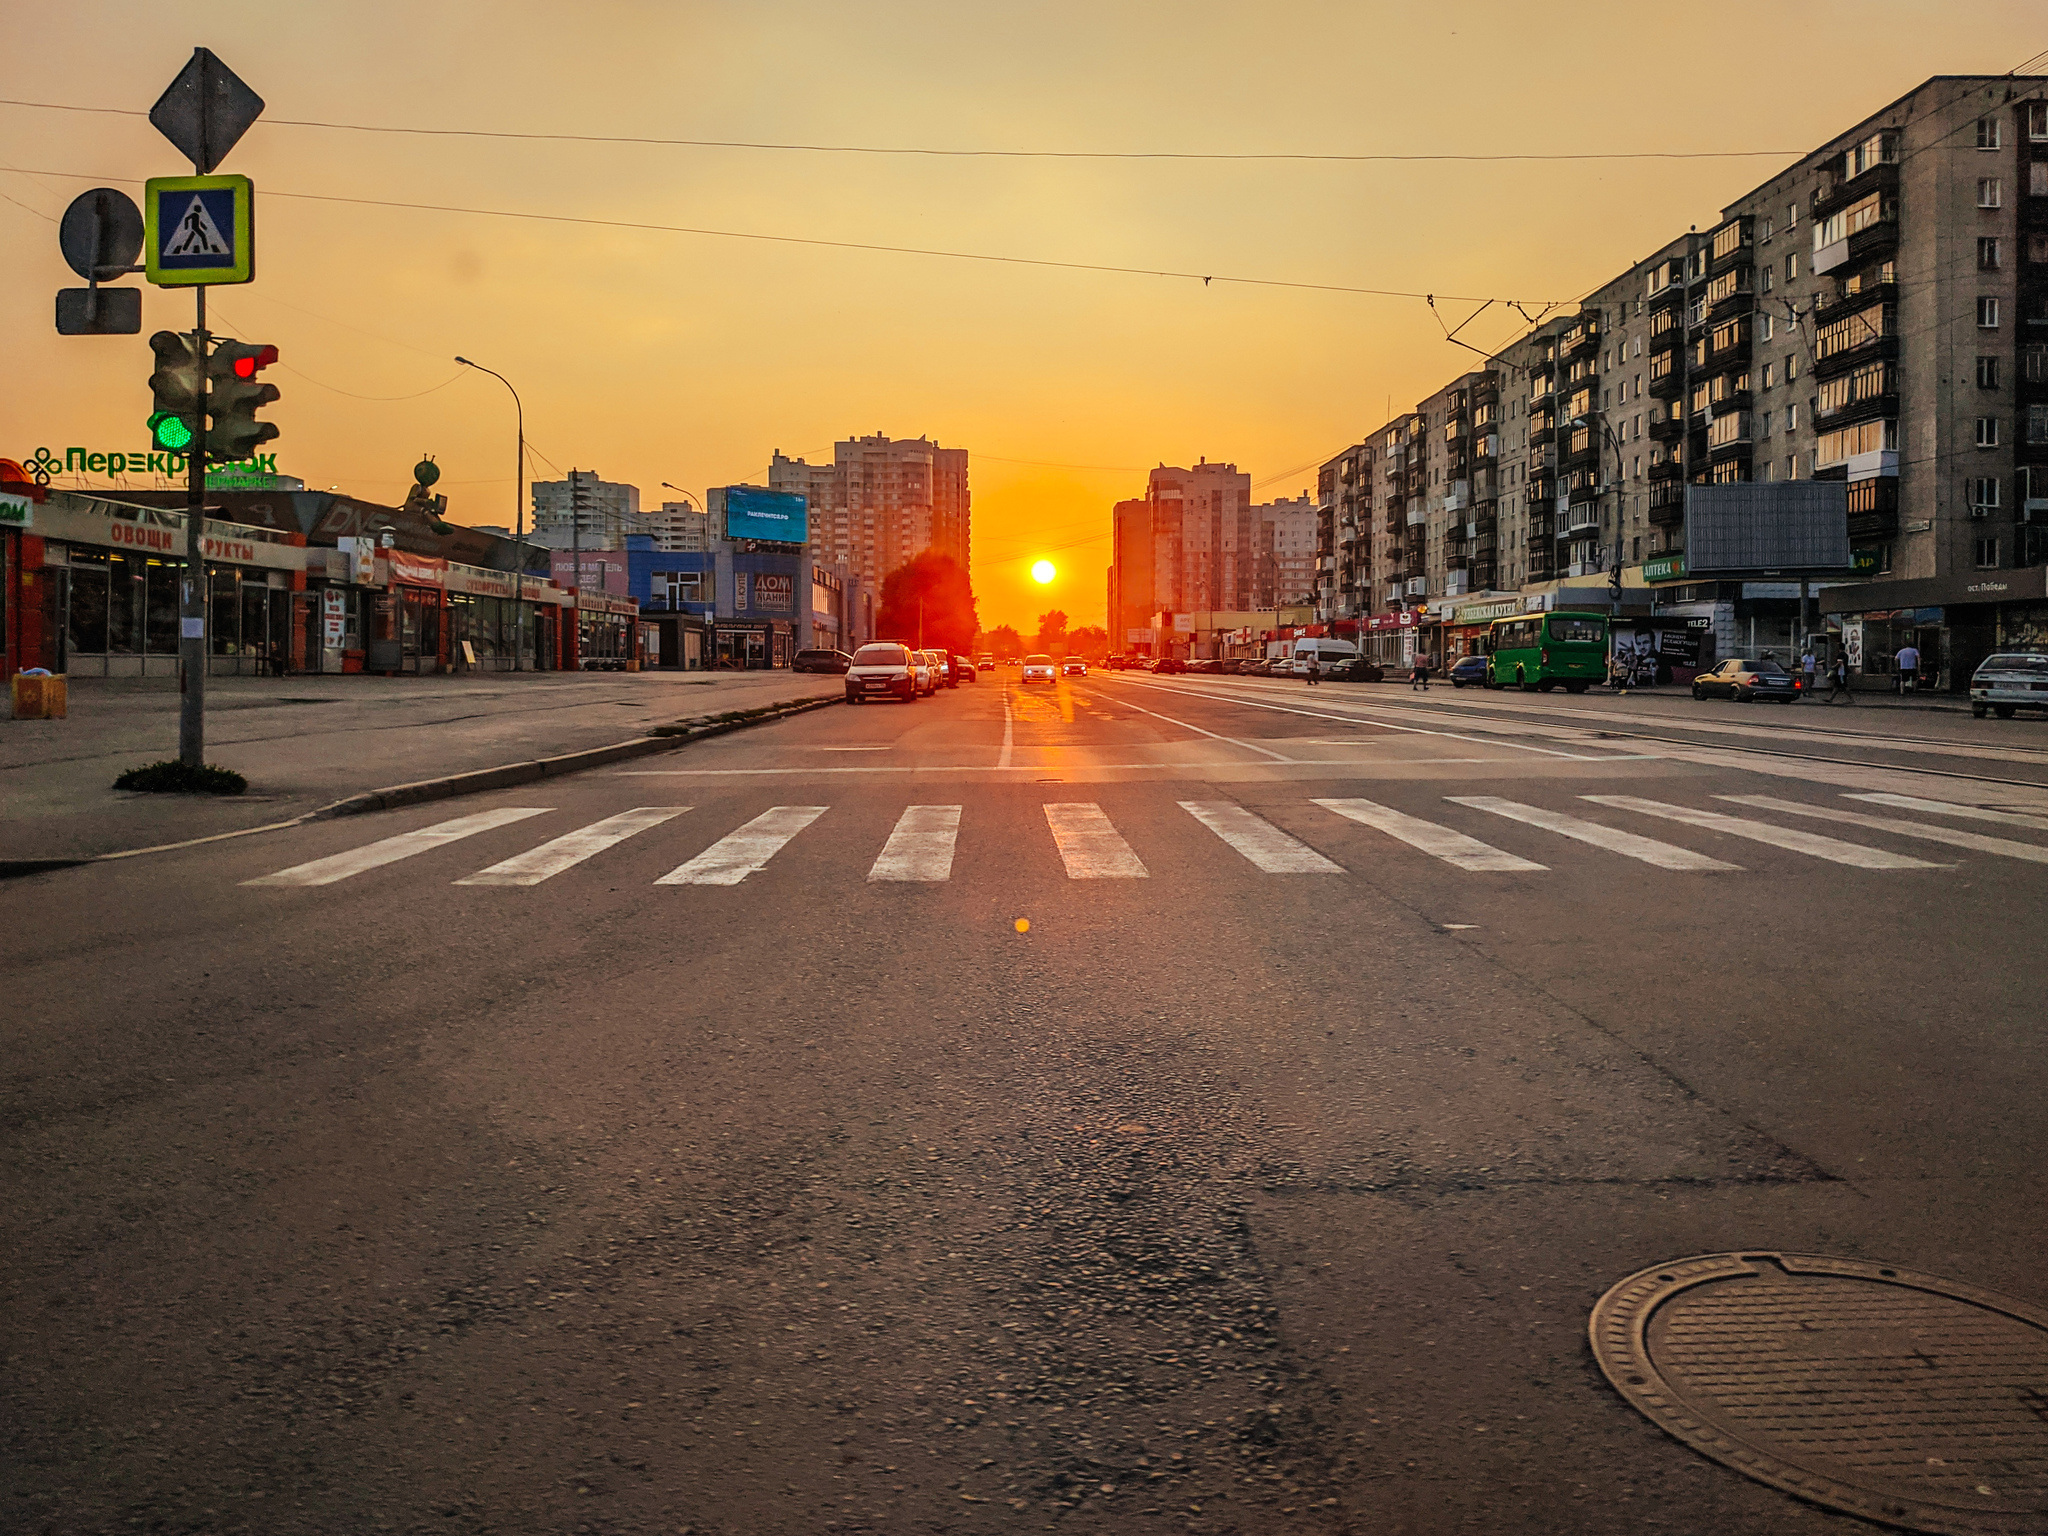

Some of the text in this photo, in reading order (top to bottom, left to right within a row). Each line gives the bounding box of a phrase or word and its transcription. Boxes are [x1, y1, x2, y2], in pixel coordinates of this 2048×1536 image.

[111, 523, 254, 561] ОВОЩИ РУКТЫ
[554, 562, 586, 572] ЛЮБЯ
[1644, 562, 1672, 577] АПТЕКА
[755, 576, 791, 590] ДОМ
[757, 591, 790, 604] МАНИЯ
[1495, 602, 1516, 618] КУХНЯ
[1688, 619, 1708, 628] TELE2
